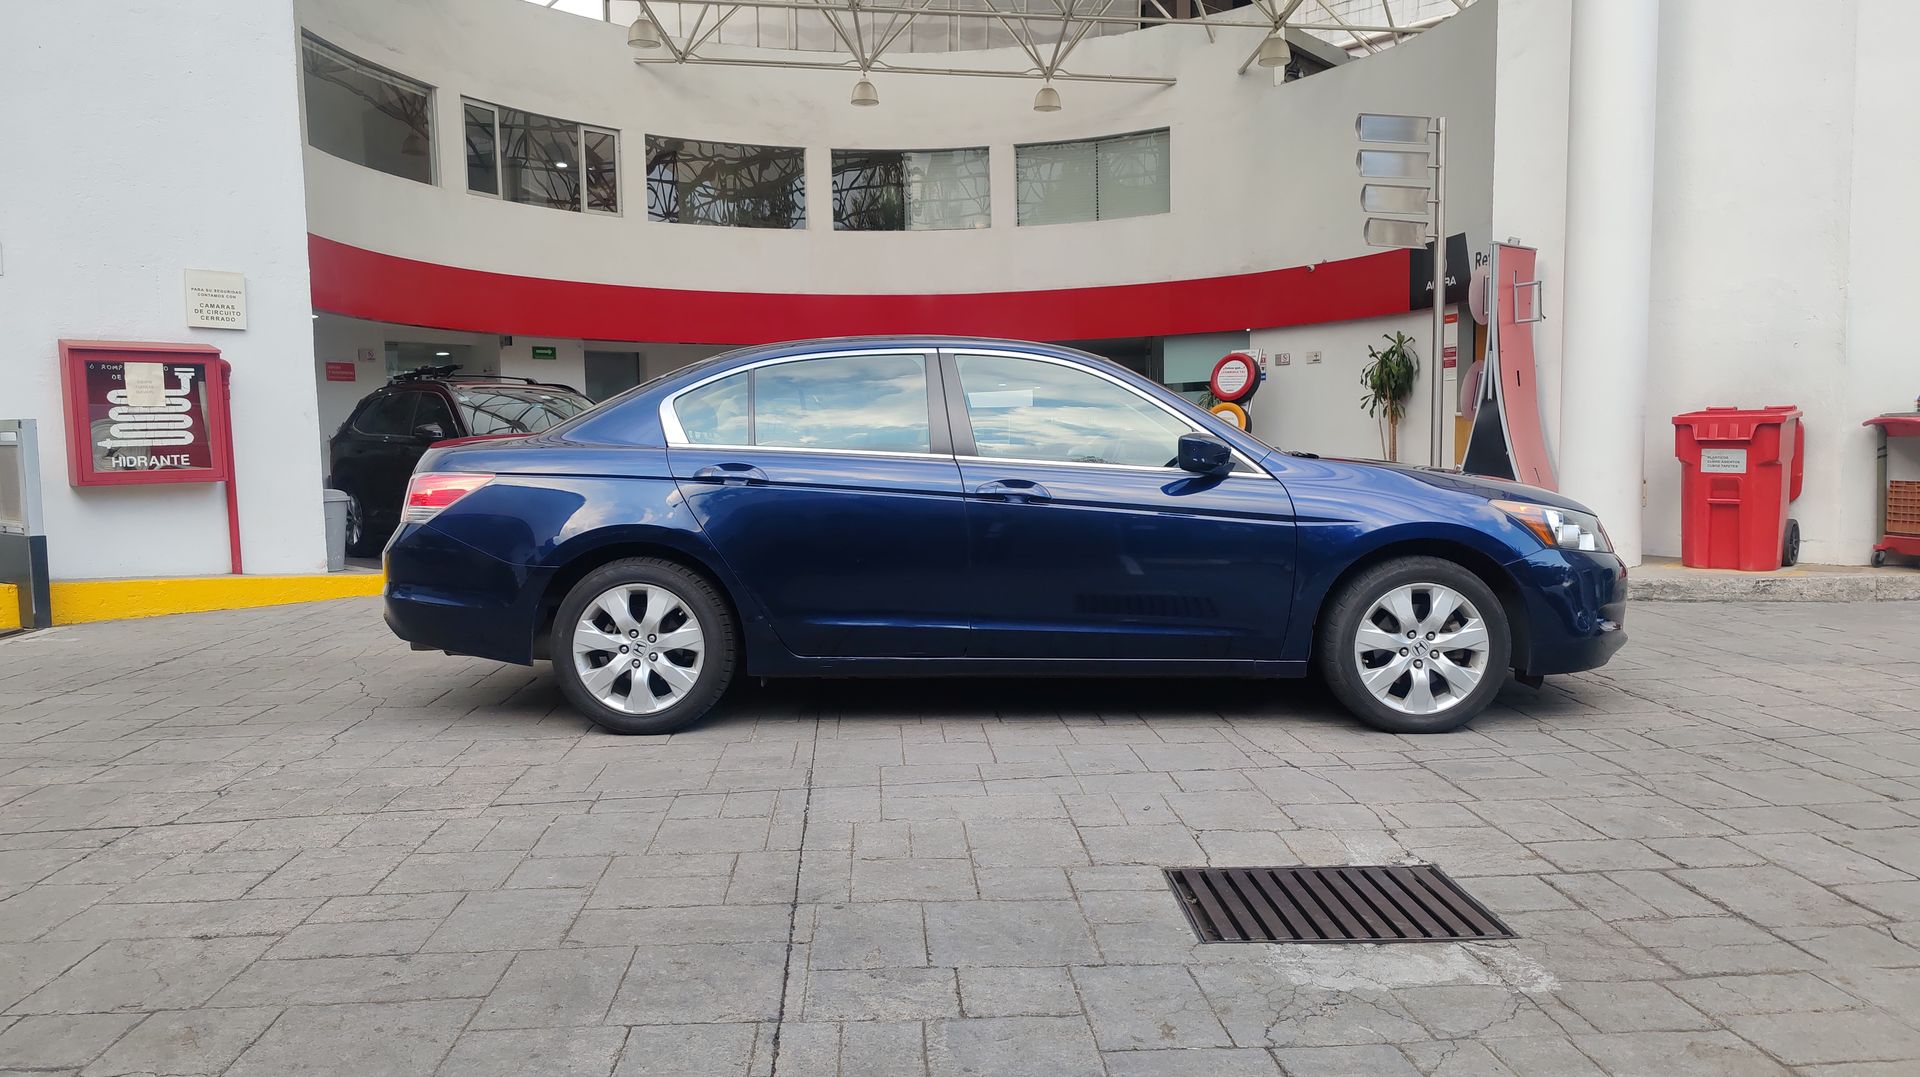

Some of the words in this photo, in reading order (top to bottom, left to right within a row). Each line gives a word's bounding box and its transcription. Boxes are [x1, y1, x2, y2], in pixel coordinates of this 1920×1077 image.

[1425, 275, 1457, 291] ARA
[199, 302, 236, 310] CAMARAS
[206, 309, 242, 317] CIRCUITO
[200, 315, 236, 323] CERRADO
[111, 454, 191, 468] HIDRANTE
